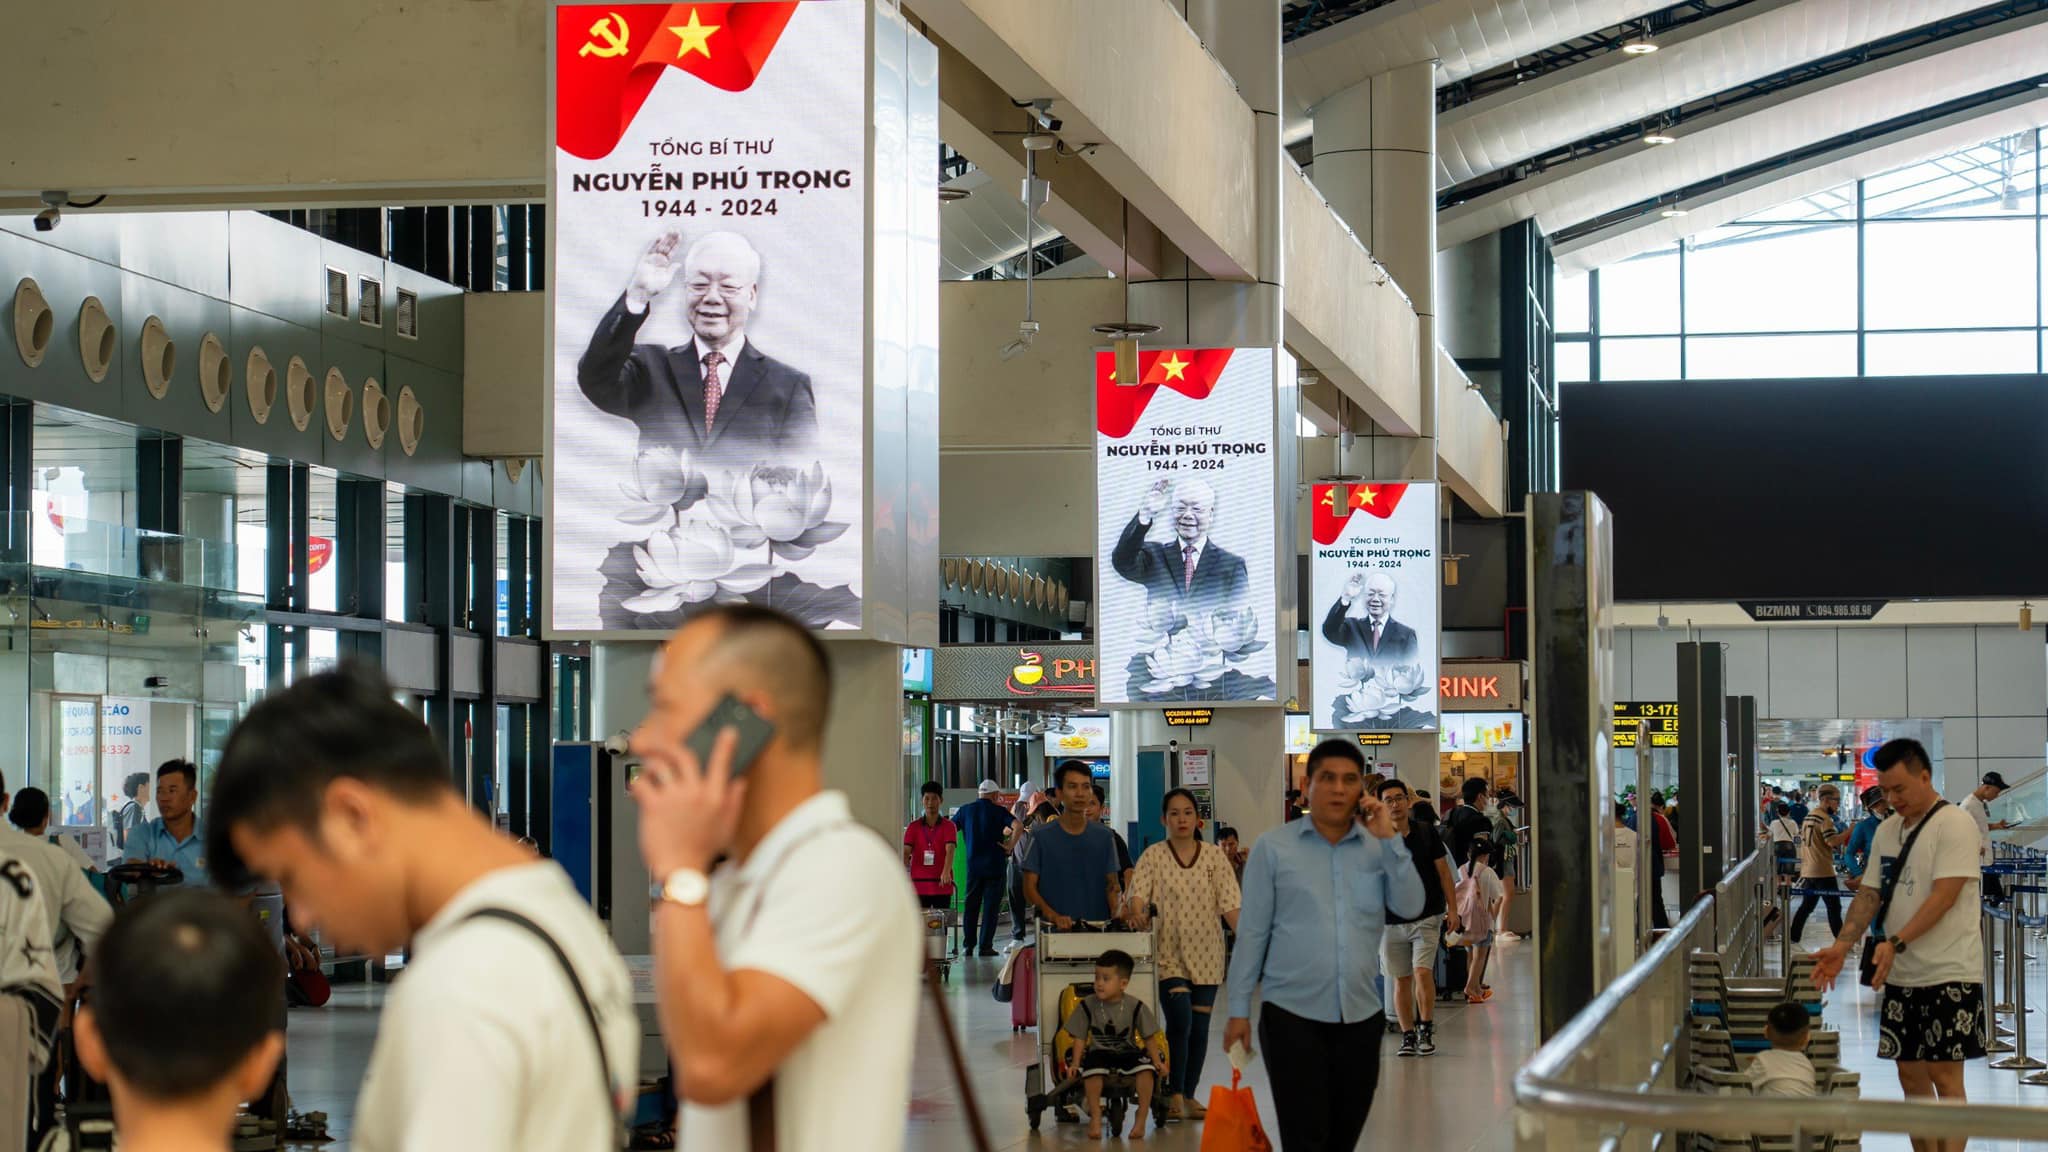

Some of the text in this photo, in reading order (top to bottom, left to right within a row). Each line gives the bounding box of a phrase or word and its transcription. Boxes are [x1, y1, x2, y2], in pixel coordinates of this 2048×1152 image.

[649, 137, 774, 156] TỔNG BÍ THƯ
[573, 163, 851, 194] NGUYỄN PHÚ TRỌNG
[642, 199, 697, 217] 1944
[721, 198, 778, 216] 2024
[1150, 424, 1222, 436] TỔNG BÍ THƯ
[1107, 440, 1266, 457] NGUYỄN PHÚ TRỌNG
[1147, 460, 1178, 471] 1944
[1192, 459, 1225, 470] 2024
[1384, 537, 1400, 545] THƯ
[1319, 546, 1431, 559] NGUYỄN PHÚ TRỌNG
[1378, 560, 1402, 568] 2024
[1755, 605, 1800, 616] BIZMAN
[1440, 675, 1499, 697] RINK
